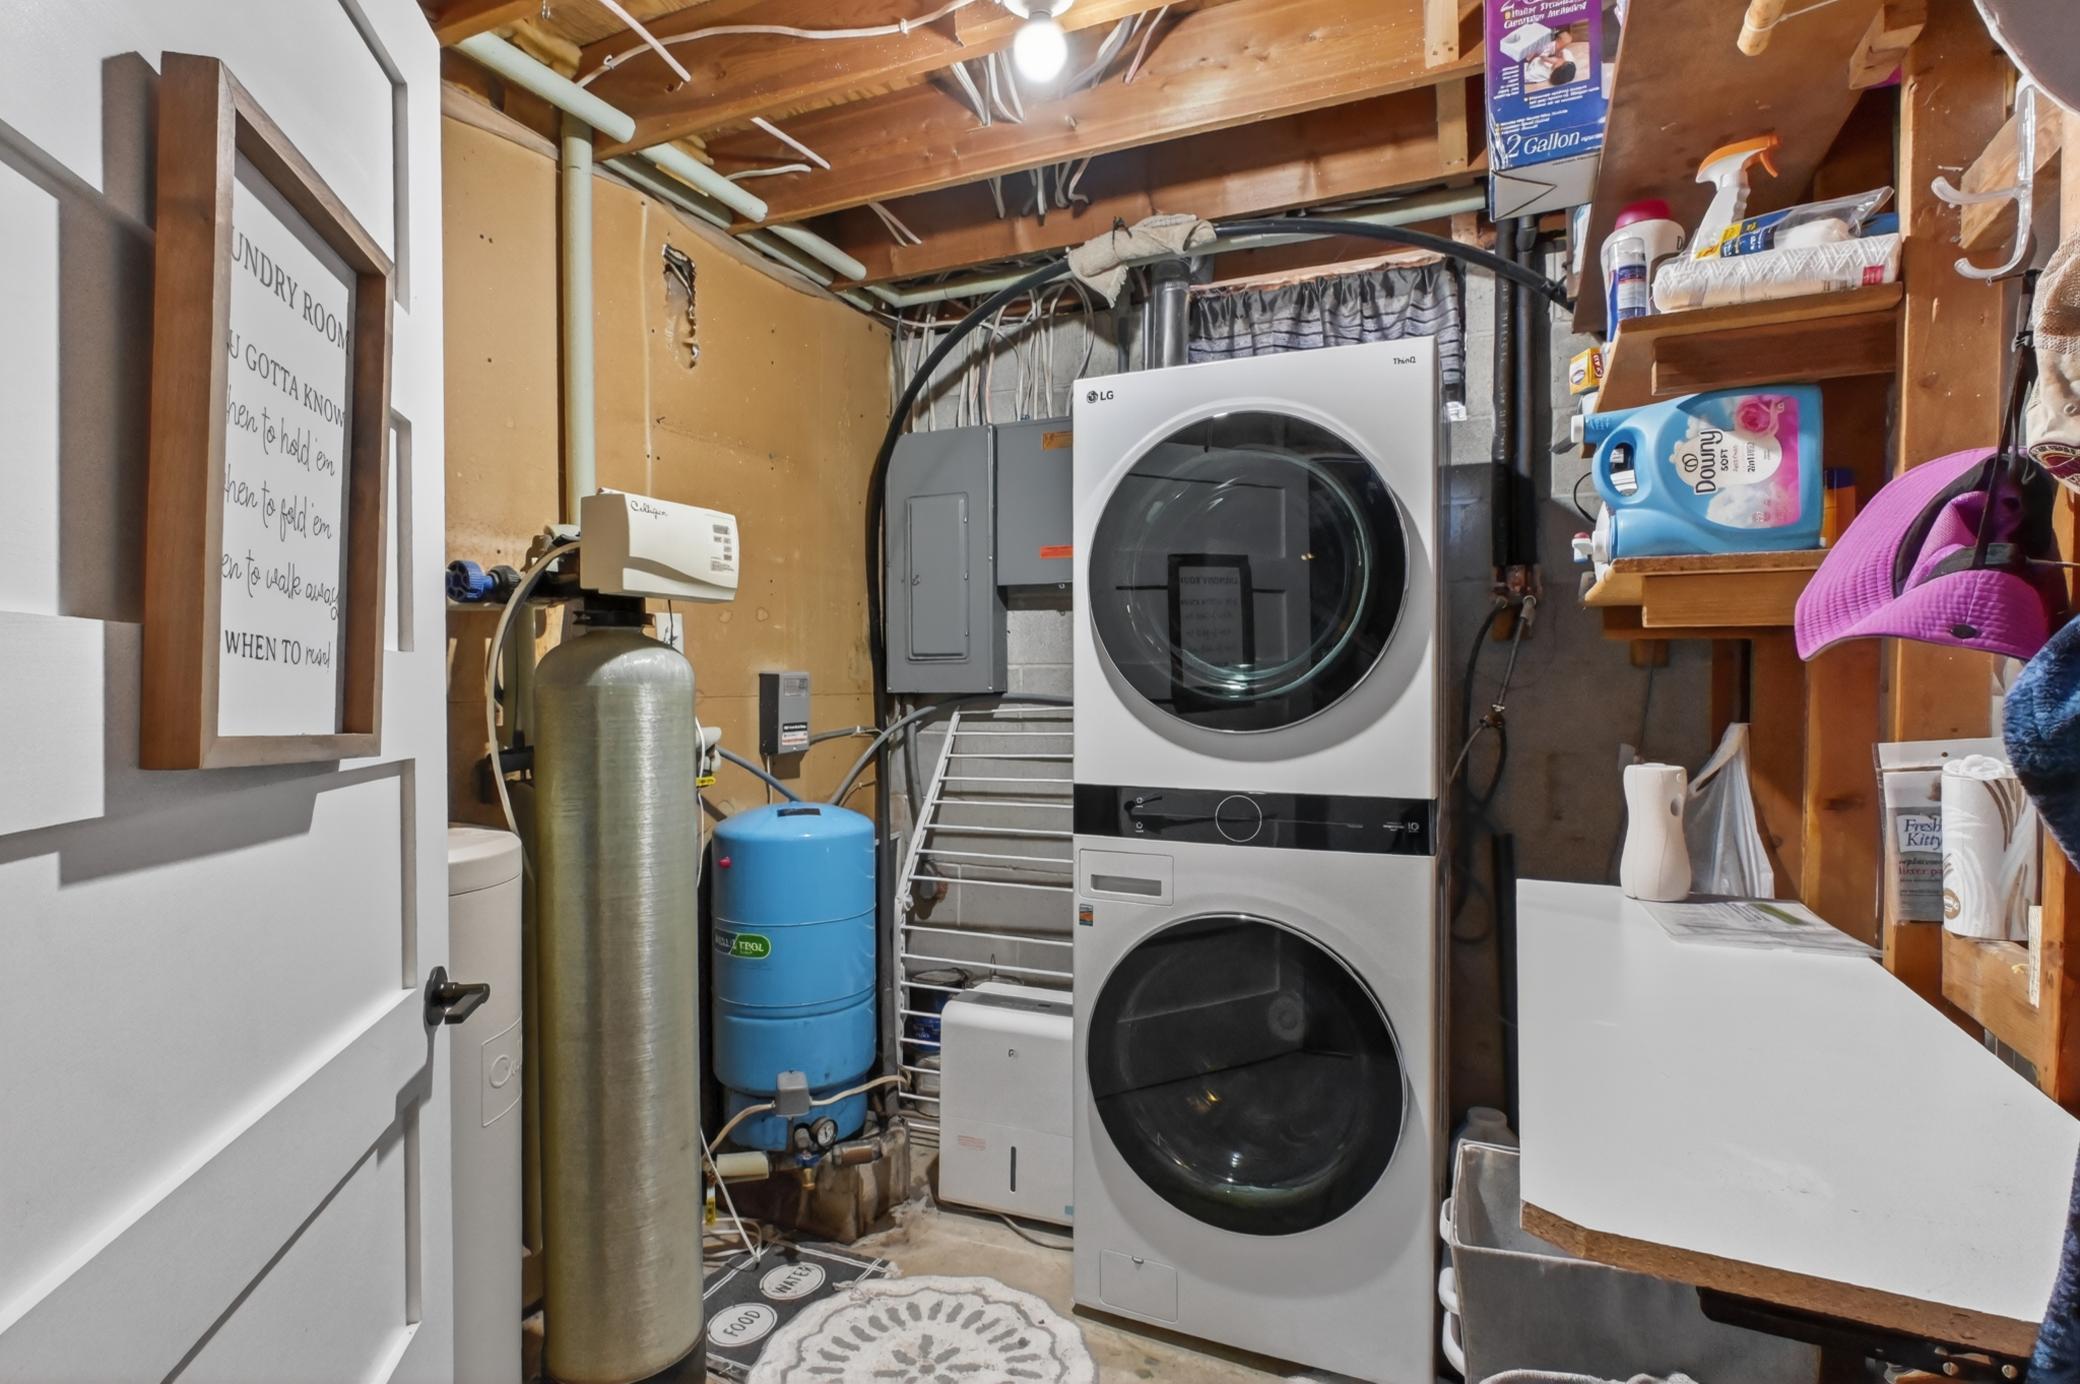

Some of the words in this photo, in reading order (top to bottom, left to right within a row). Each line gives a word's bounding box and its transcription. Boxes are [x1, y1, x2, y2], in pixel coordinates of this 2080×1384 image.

[1506, 134, 1521, 158] 2
[1523, 131, 1580, 155] Gallon
[245, 343, 299, 401] GOTTA
[303, 383, 345, 428] KNOW
[1100, 390, 1114, 401] LG
[261, 406, 276, 456] to
[280, 417, 310, 472] hold
[1695, 430, 1724, 494] Downy
[1720, 449, 1729, 472] SOFT
[261, 480, 276, 529] to
[280, 495, 307, 542] fold
[245, 549, 261, 598] to
[266, 562, 302, 600] walk
[305, 582, 340, 621] away
[224, 629, 277, 662] WHEN
[282, 639, 302, 665] TO
[1904, 818, 1942, 833] Fresh
[1906, 832, 1943, 851] Kitty
[773, 1262, 815, 1296] WATER
[723, 1309, 761, 1338] FOOD
